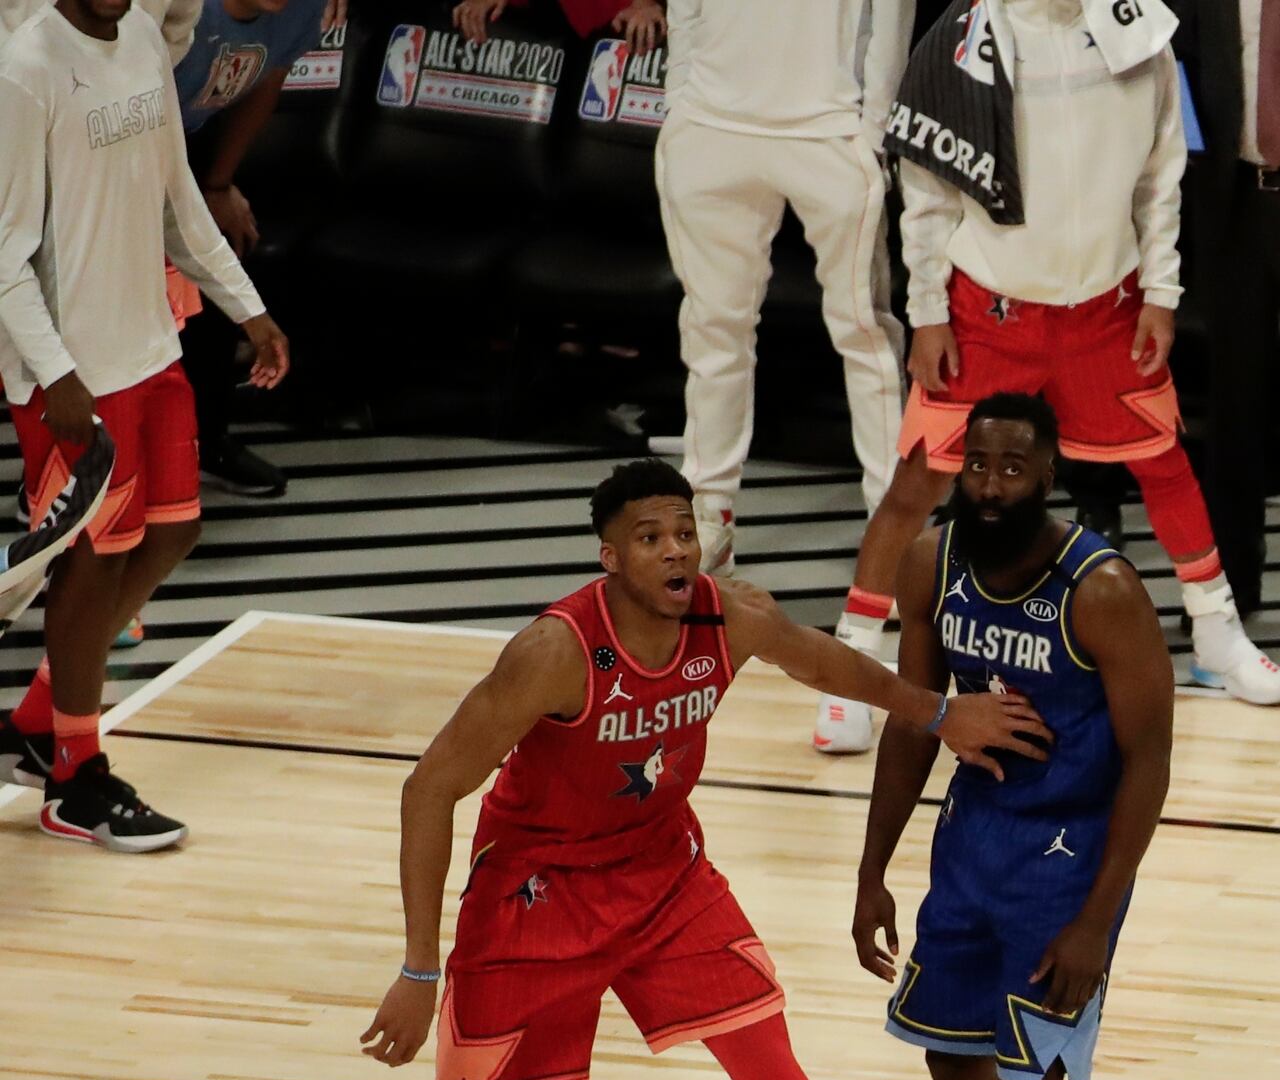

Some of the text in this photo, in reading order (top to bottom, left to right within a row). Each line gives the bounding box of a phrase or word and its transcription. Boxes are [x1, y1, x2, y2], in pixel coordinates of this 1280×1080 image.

[452, 87, 520, 106] CHICAGO
[942, 613, 1053, 674] ALL-STAR
[596, 685, 718, 742] ALL-STAR
